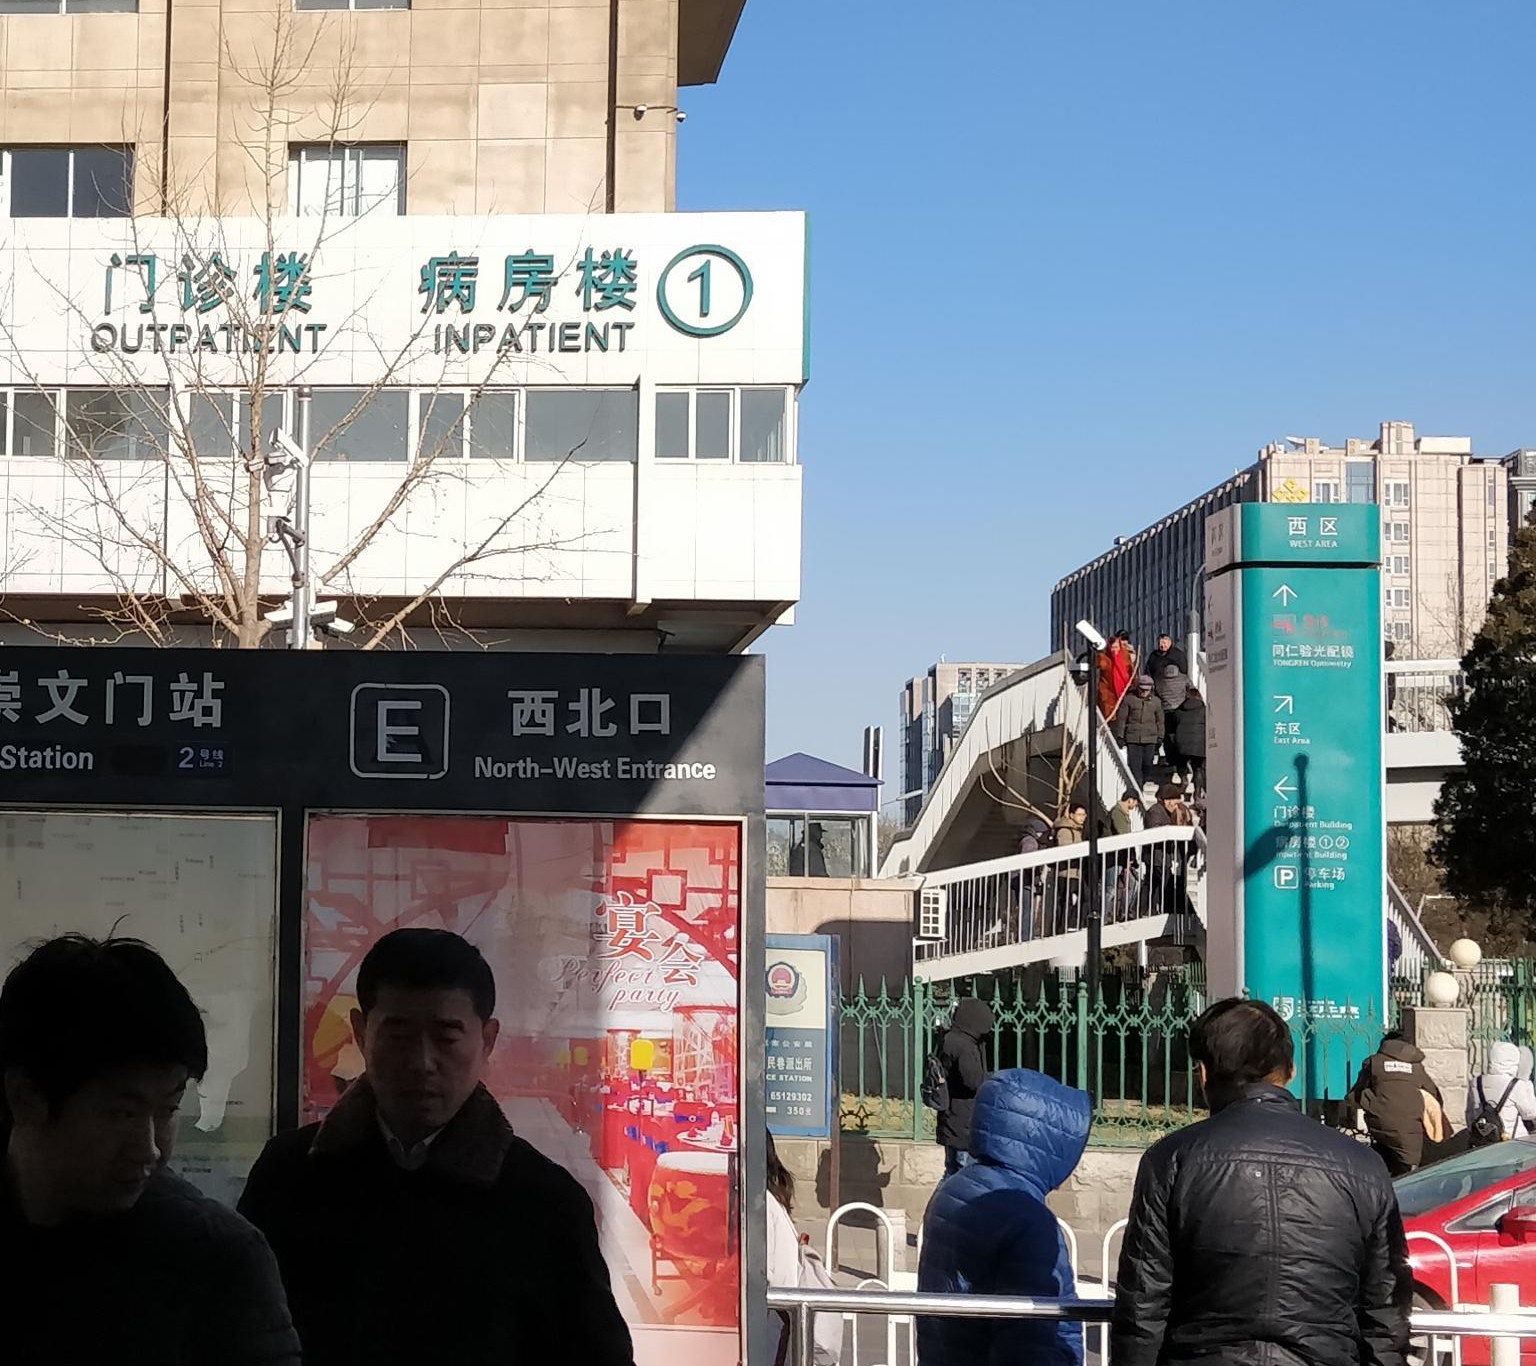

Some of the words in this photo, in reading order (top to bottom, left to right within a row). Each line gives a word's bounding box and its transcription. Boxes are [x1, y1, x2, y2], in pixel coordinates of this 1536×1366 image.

[104, 250, 315, 316] 门诊楼
[418, 247, 639, 316] 病房楼
[90, 323, 327, 355] OUTPATIENT
[434, 321, 636, 354] INPATIENT
[1287, 516, 1338, 536] 西区
[1289, 539, 1313, 548] WEST
[1315, 539, 1338, 548] AREA
[1272, 644, 1354, 659] 同仁验光配镜
[507, 687, 671, 738] 西北口
[377, 700, 423, 763] E
[1274, 722, 1301, 735] 东区
[1274, 736, 1290, 745] East
[1291, 736, 1310, 745] Area
[0, 744, 95, 771] Station
[617, 756, 717, 781] Entrance
[1319, 820, 1353, 831] Building
[1314, 851, 1347, 861] Building
[543, 958, 656, 994] Perfect
[608, 988, 680, 1013] party
[779, 1074, 813, 1082] STATION
